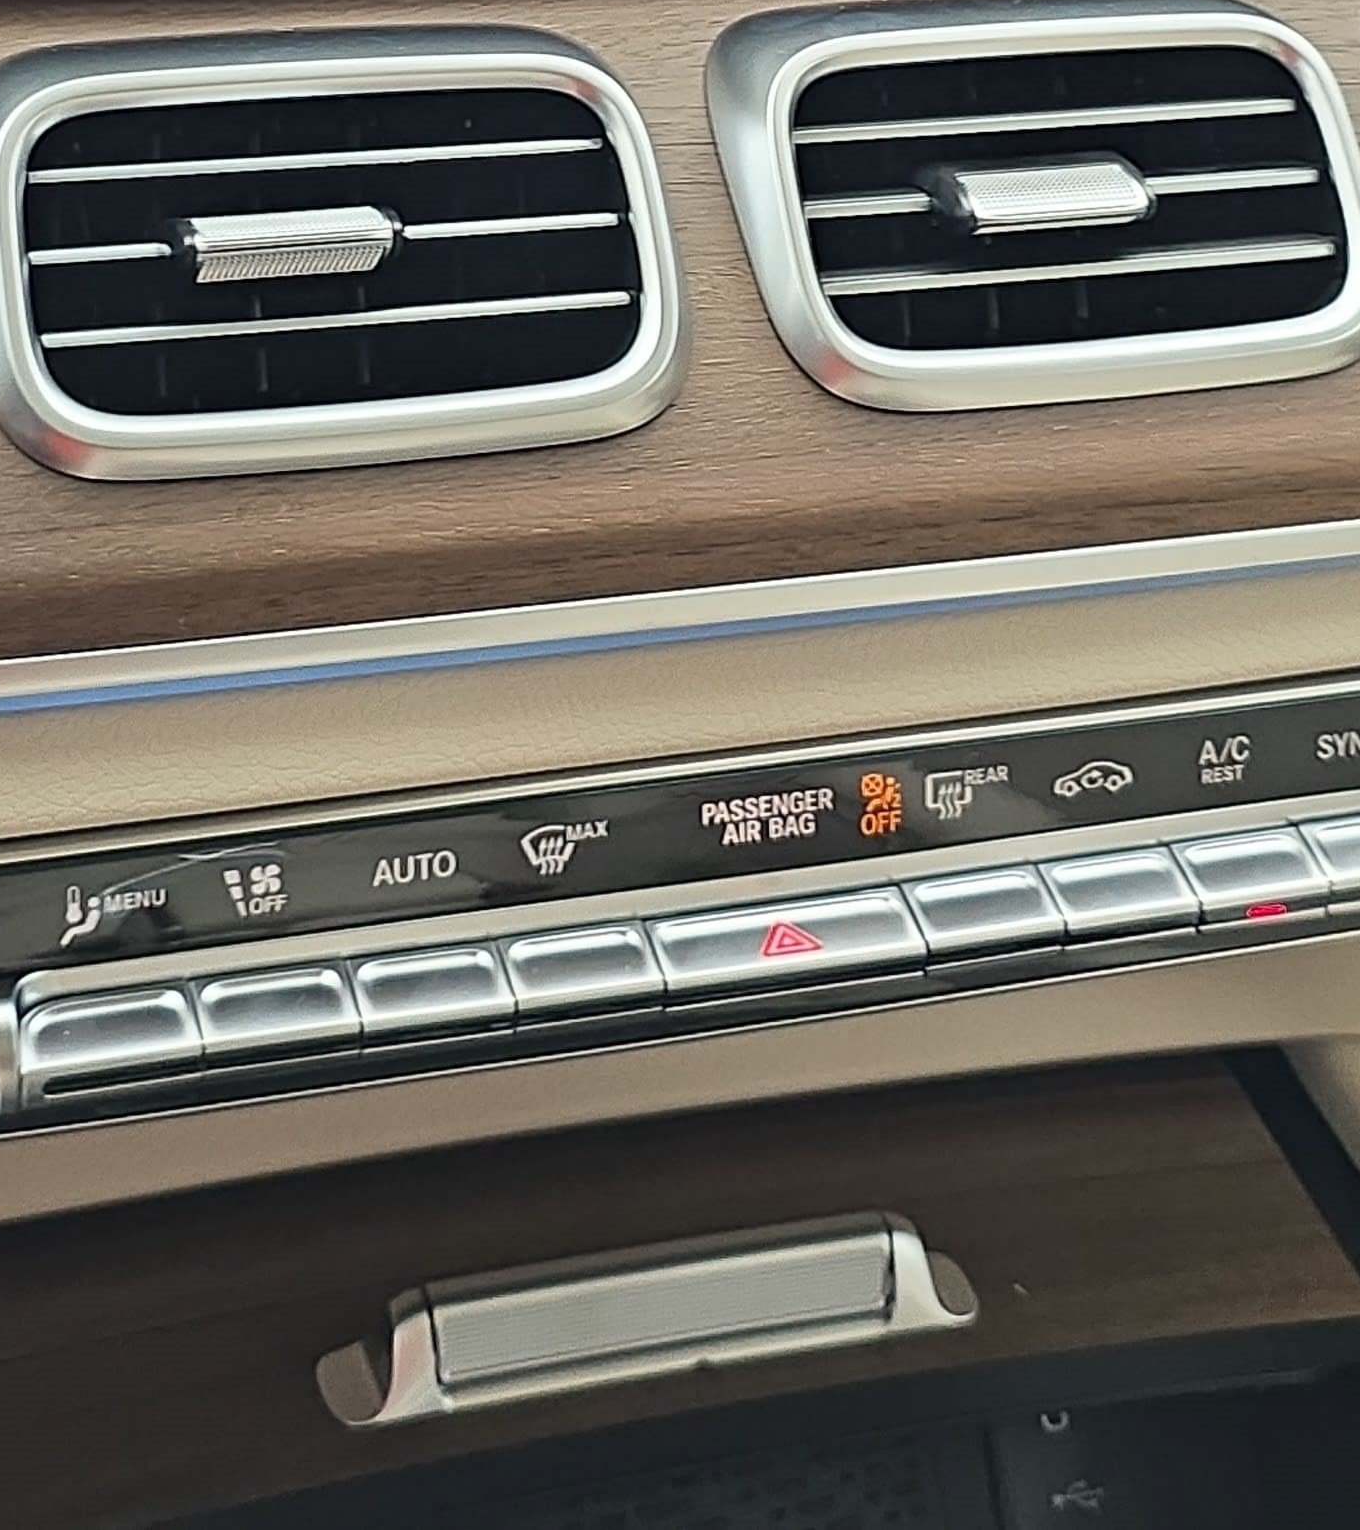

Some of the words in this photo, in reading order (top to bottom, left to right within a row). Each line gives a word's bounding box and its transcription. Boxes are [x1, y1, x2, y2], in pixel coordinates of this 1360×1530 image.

[1198, 734, 1251, 767] A/C
[963, 765, 1009, 786] REAR
[1200, 764, 1245, 785] REST
[701, 788, 834, 826] PASSENGER
[566, 820, 609, 841] MAX
[721, 820, 763, 846] AIR
[768, 814, 817, 839] BAG
[860, 809, 902, 836] OFF
[372, 850, 458, 888] AUTO
[102, 888, 168, 912] MENU
[247, 894, 288, 916] OFF
